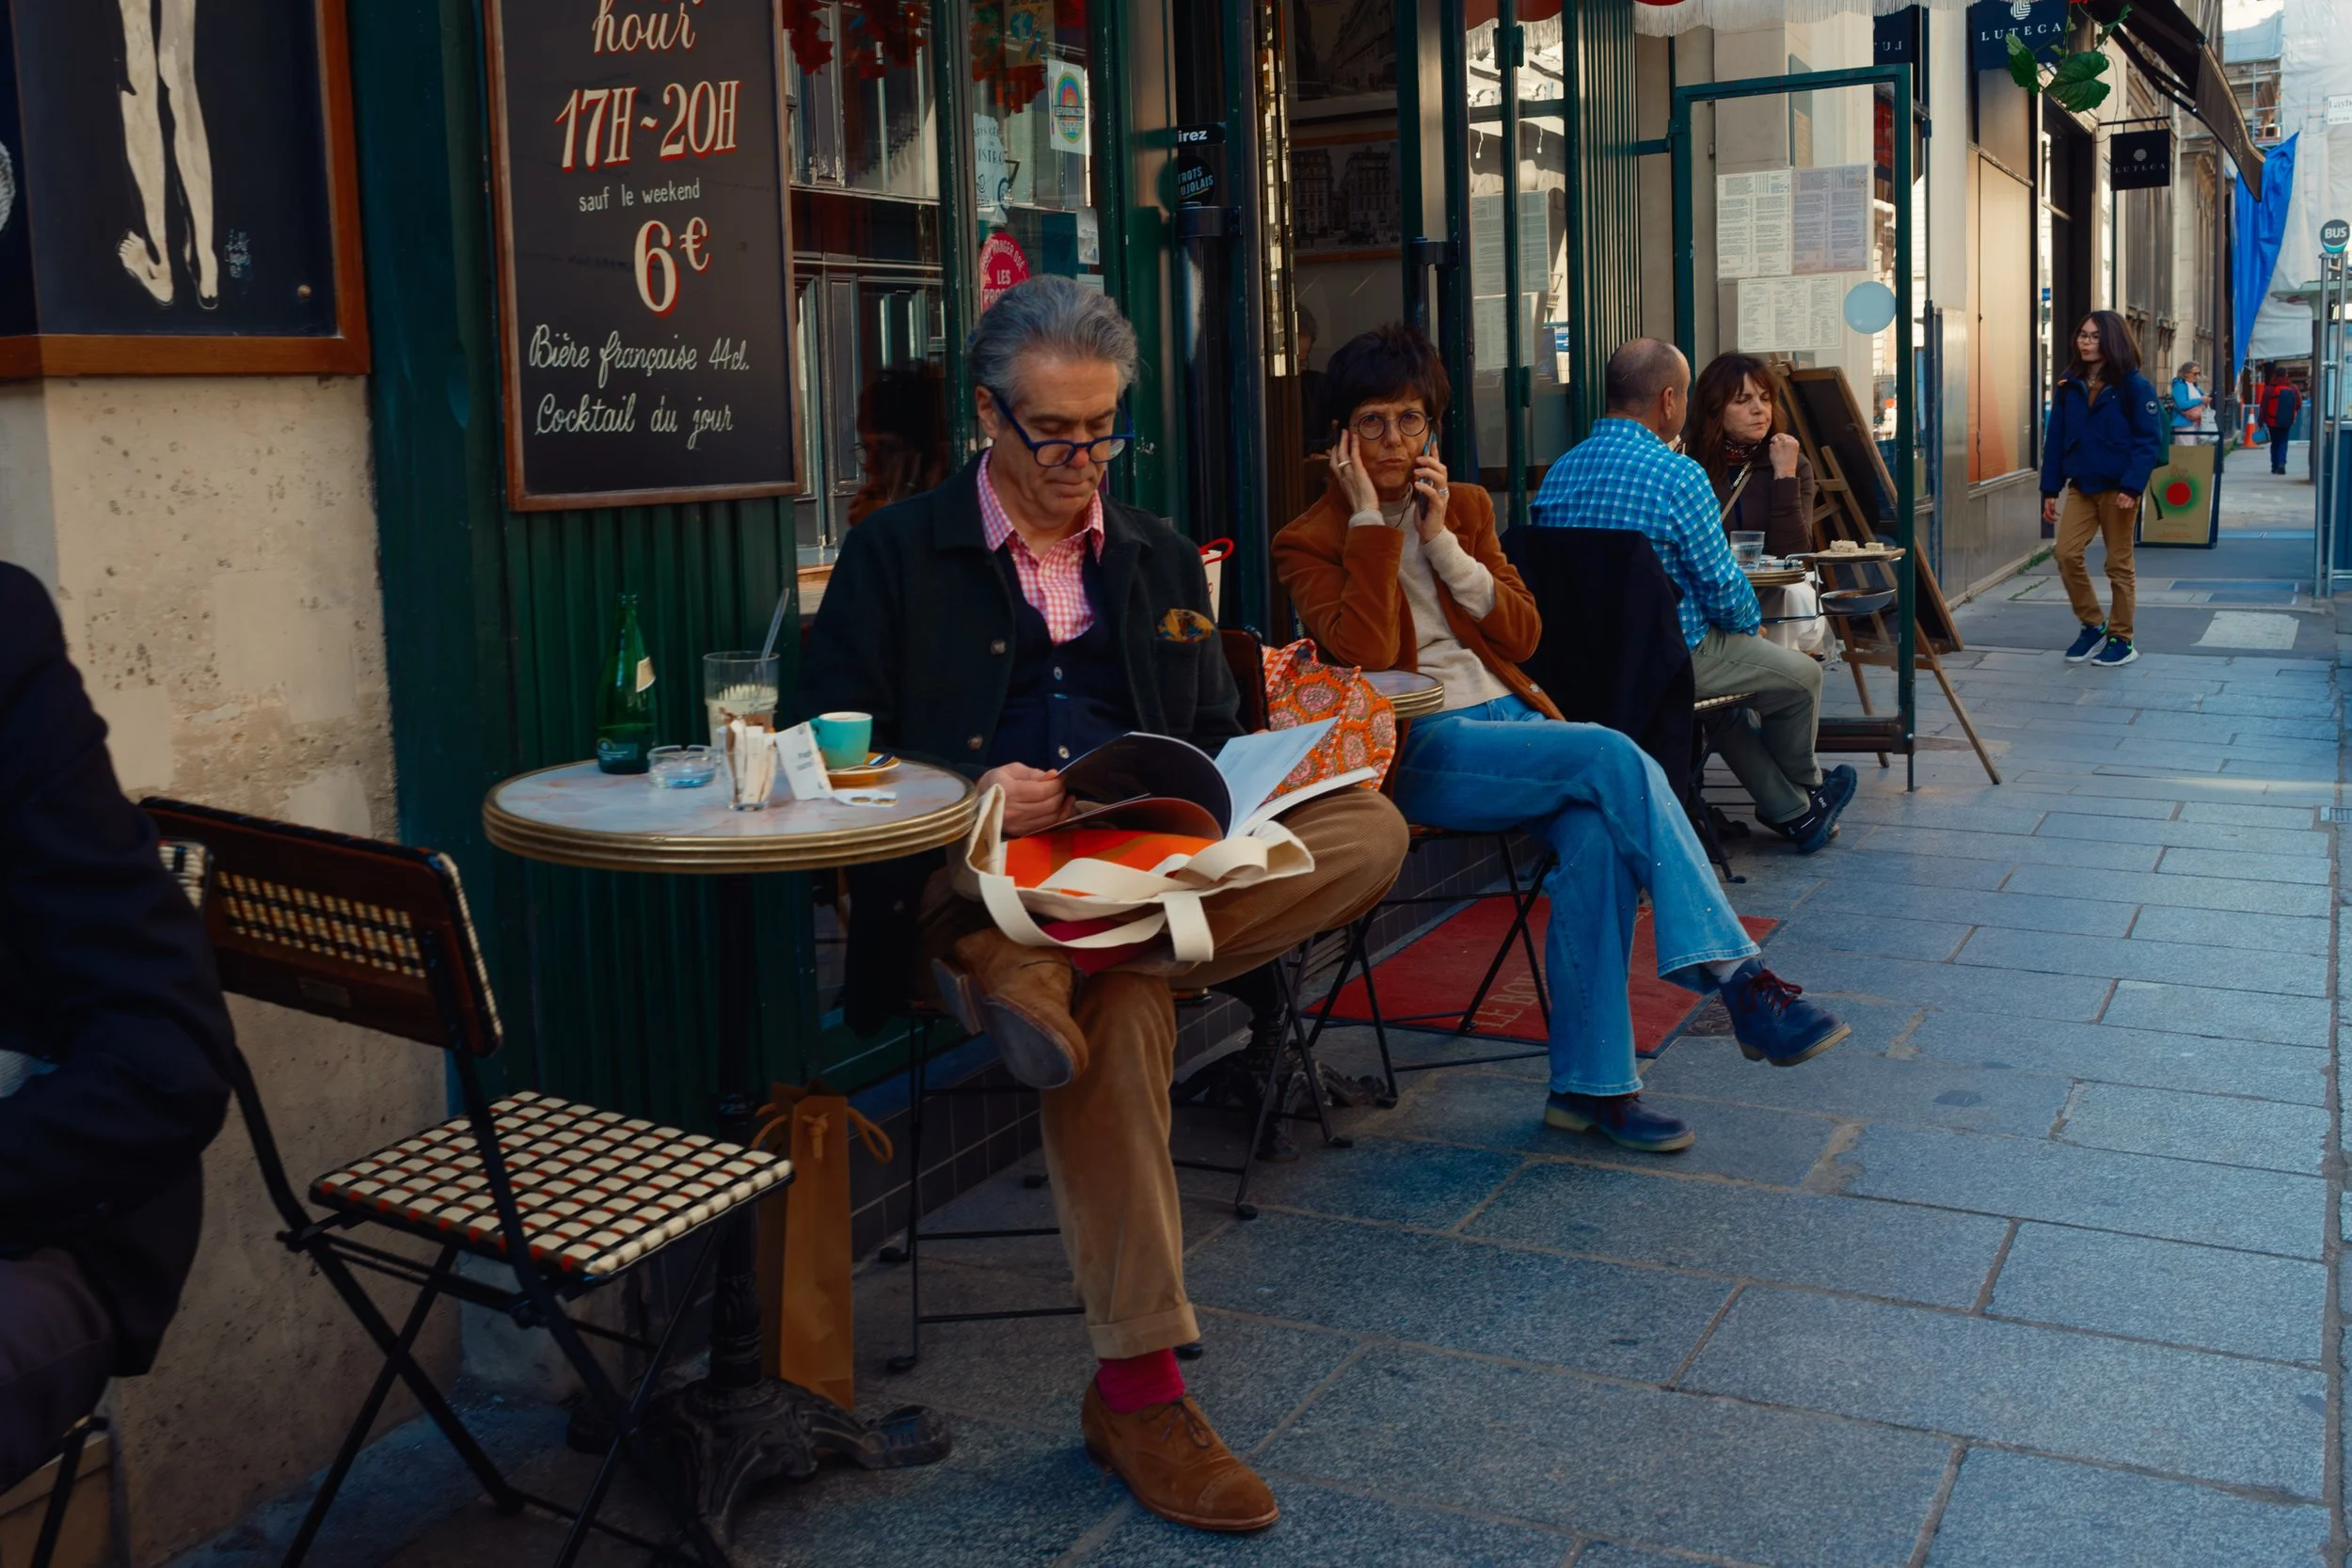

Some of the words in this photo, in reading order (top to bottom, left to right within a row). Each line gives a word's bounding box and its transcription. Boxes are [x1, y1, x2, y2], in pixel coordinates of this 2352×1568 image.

[592, 0, 696, 54] hour
[1980, 23, 2062, 41] LUTECA
[1178, 130, 1208, 142] irez
[2115, 163, 2166, 174] LUTECA
[579, 186, 610, 213] sauf
[621, 183, 635, 207] le
[642, 177, 701, 204] weekend
[2325, 227, 2347, 239] BUS
[997, 269, 1011, 285] LES
[529, 324, 591, 369] Bière
[598, 330, 698, 388] française
[534, 393, 636, 436] Cocktail
[650, 395, 678, 433] du
[687, 396, 734, 451] jour
